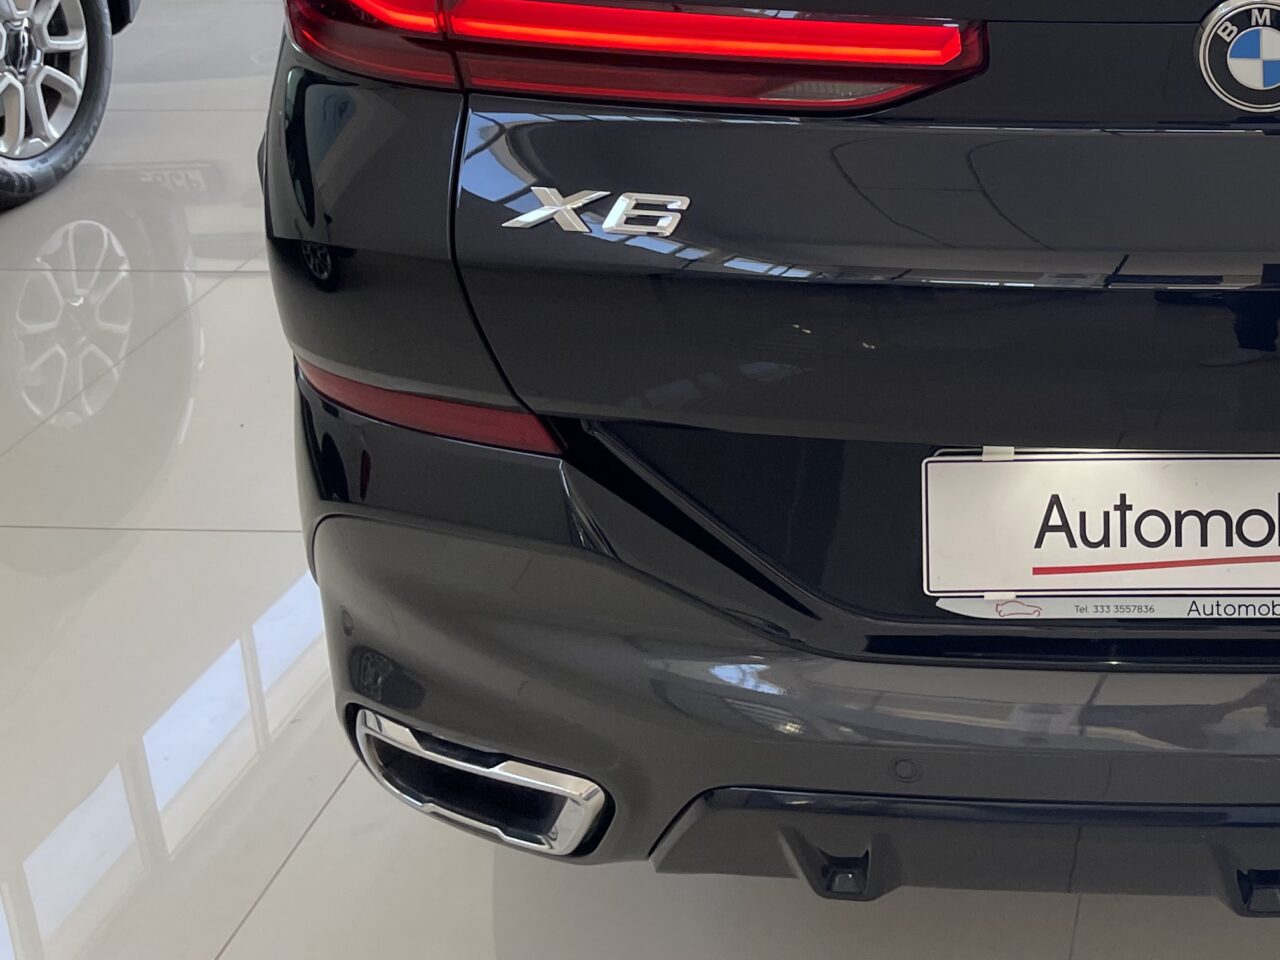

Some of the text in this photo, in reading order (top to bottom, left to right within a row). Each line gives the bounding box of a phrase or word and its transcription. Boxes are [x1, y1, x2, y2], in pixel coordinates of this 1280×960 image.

[501, 186, 691, 237] X6
[1092, 604, 1111, 615] 333
[1113, 604, 1155, 615] 3557836
